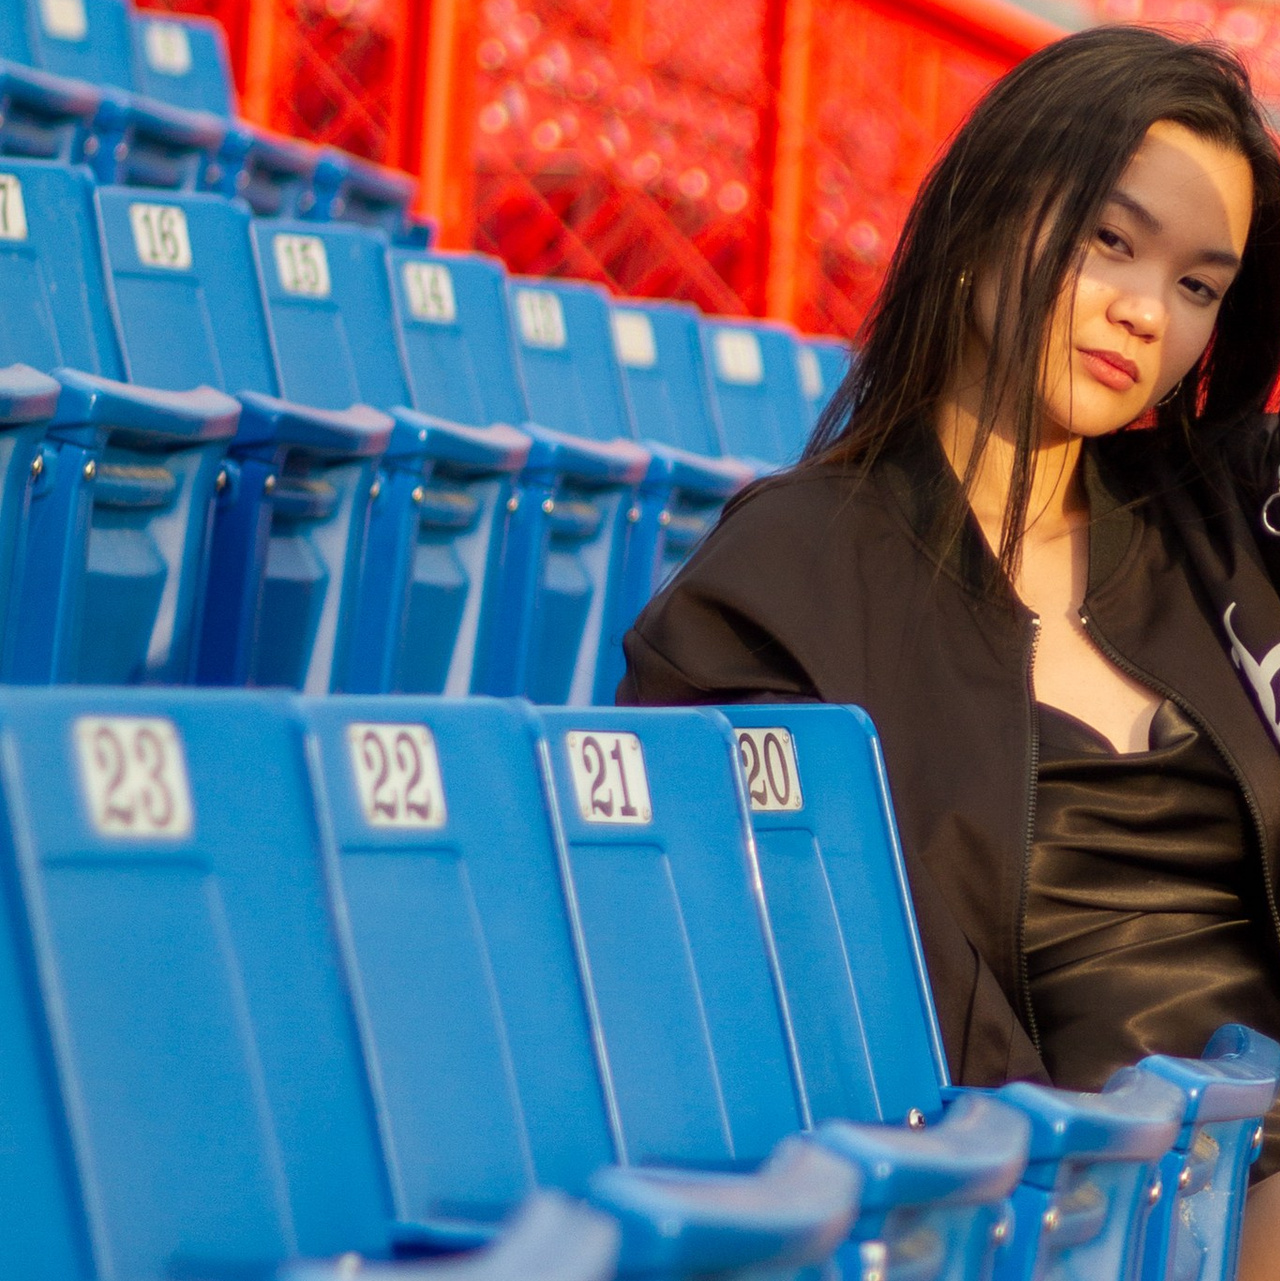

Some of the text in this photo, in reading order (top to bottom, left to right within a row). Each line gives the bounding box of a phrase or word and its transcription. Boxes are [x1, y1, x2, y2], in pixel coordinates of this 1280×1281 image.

[142, 208, 180, 261] 16
[284, 242, 321, 291] 15
[94, 726, 174, 828] 23
[363, 730, 432, 821] 22
[582, 736, 637, 817] 21
[739, 732, 790, 806] 20
